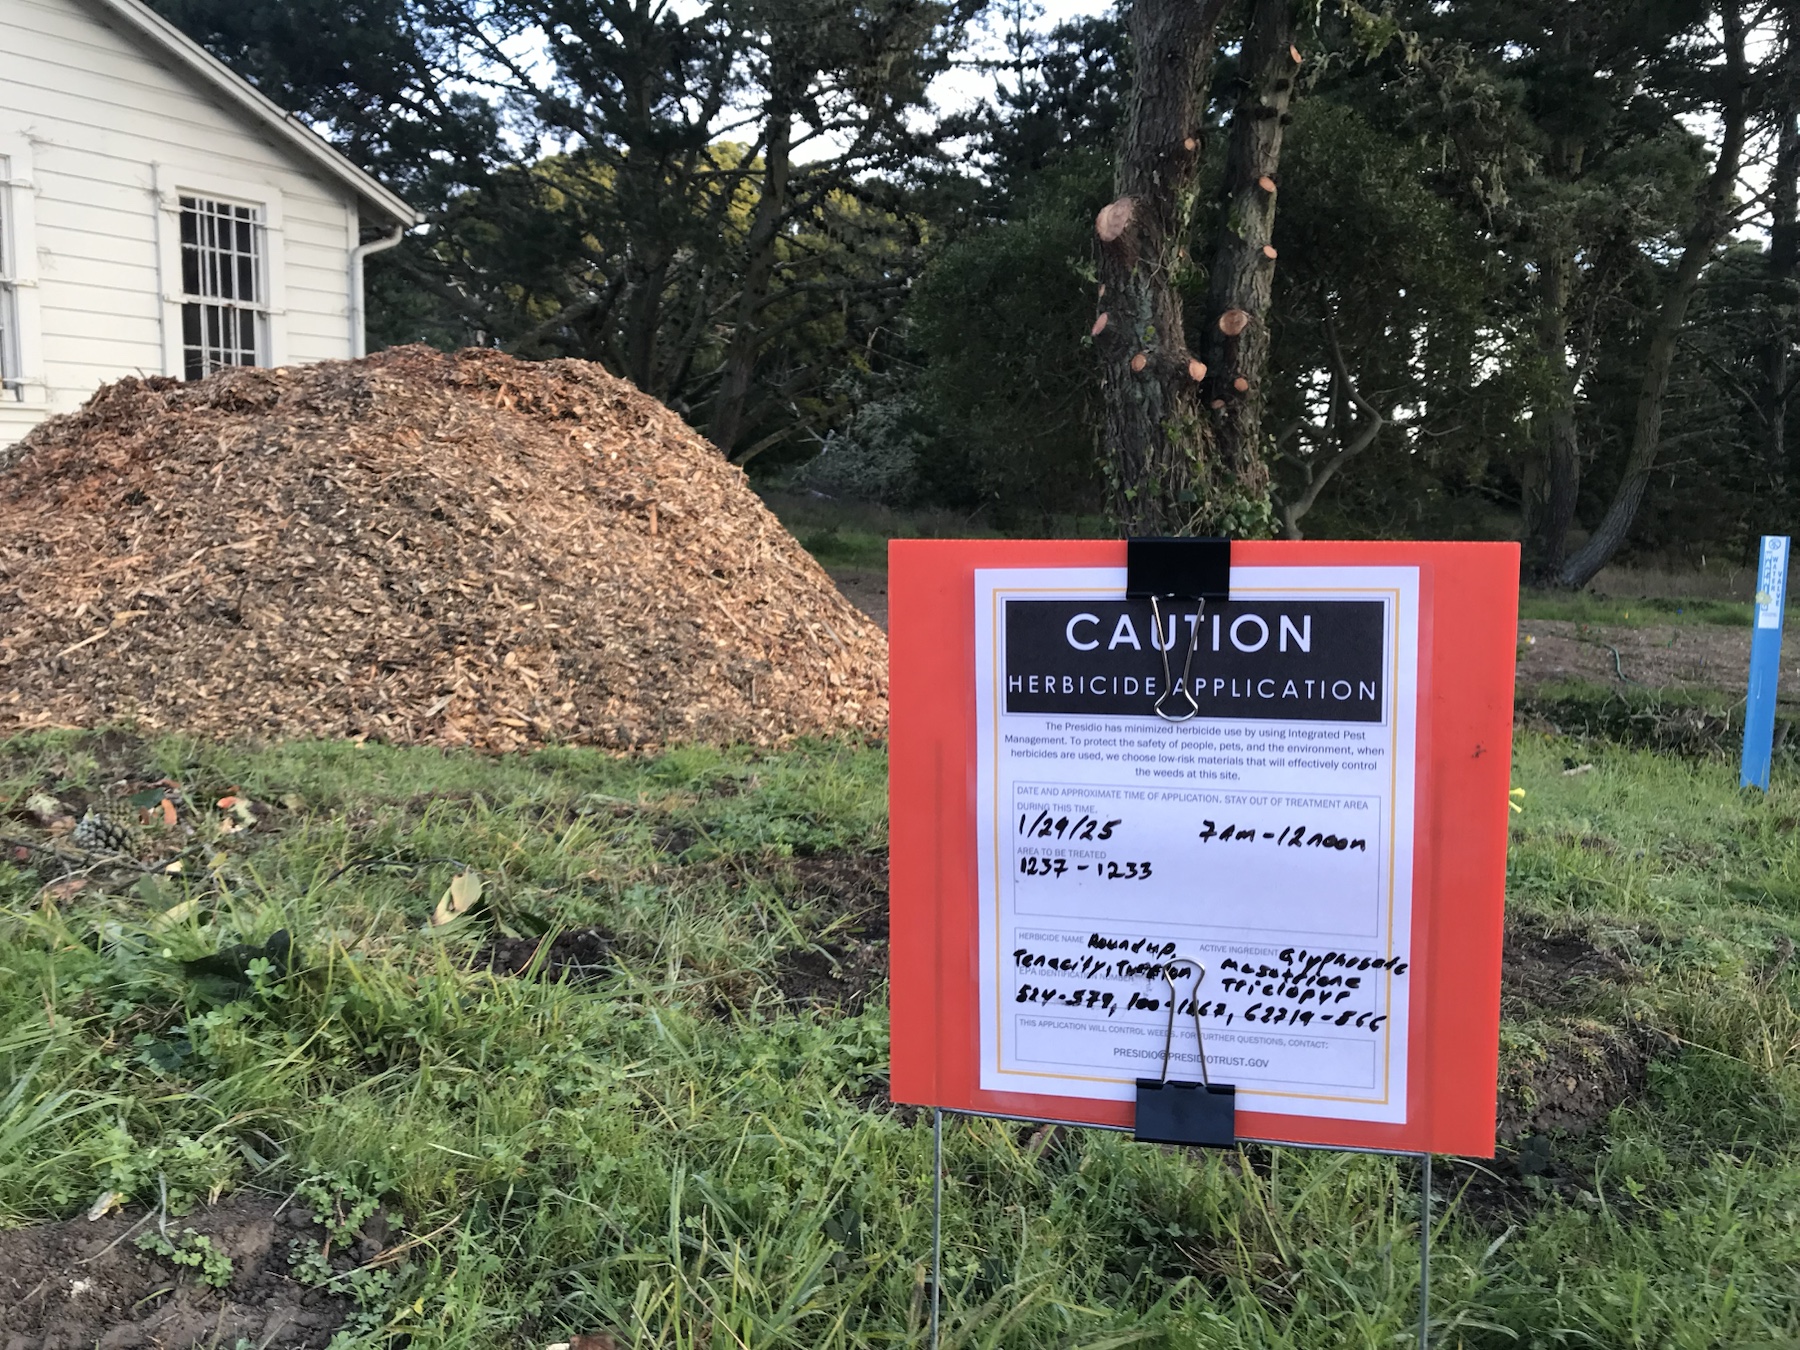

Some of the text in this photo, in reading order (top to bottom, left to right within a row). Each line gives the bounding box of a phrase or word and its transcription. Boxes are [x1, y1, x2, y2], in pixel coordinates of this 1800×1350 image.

[1066, 612, 1311, 653] CAUTION
[1009, 674, 1376, 701] HERBICIDE APPLICATION
[1046, 721, 1366, 741] The Presidio has minimized herbicide use by using Integrated Pest
[1004, 734, 1384, 756] Management. To protect the safety of people, pets, and the environment, when
[1011, 749, 1377, 771] herbicides are used, we choose low-risk materials that will effectively control
[1135, 767, 1240, 780] the weeds at this site.
[1017, 786, 1369, 810] DATE AND APPROXIMATE TIME OF APPLICATION. STAY OUT OF TREATMENT AREA
[1017, 802, 1098, 814] DURING THIS TIME.
[1018, 809, 1122, 842] 1/29/25
[1017, 847, 1107, 859] AREA TO BE TREATED
[1018, 932, 1084, 944] HERBICIDE NAME
[1199, 944, 1279, 957] ACTIVE INGREDIENT
[1019, 966, 1037, 976] EPA
[1020, 1018, 1037, 1027] THIS
[1038, 1020, 1087, 1031] APPLICATION
[1088, 1024, 1107, 1033] WILL
[1108, 1026, 1146, 1036] CONTROL
[1180, 1031, 1197, 1039] FOR
[1199, 1032, 1236, 1042] URTHER
[1237, 1035, 1286, 1046] QUESTIONS,
[1288, 1039, 1329, 1049] CONTACT:
